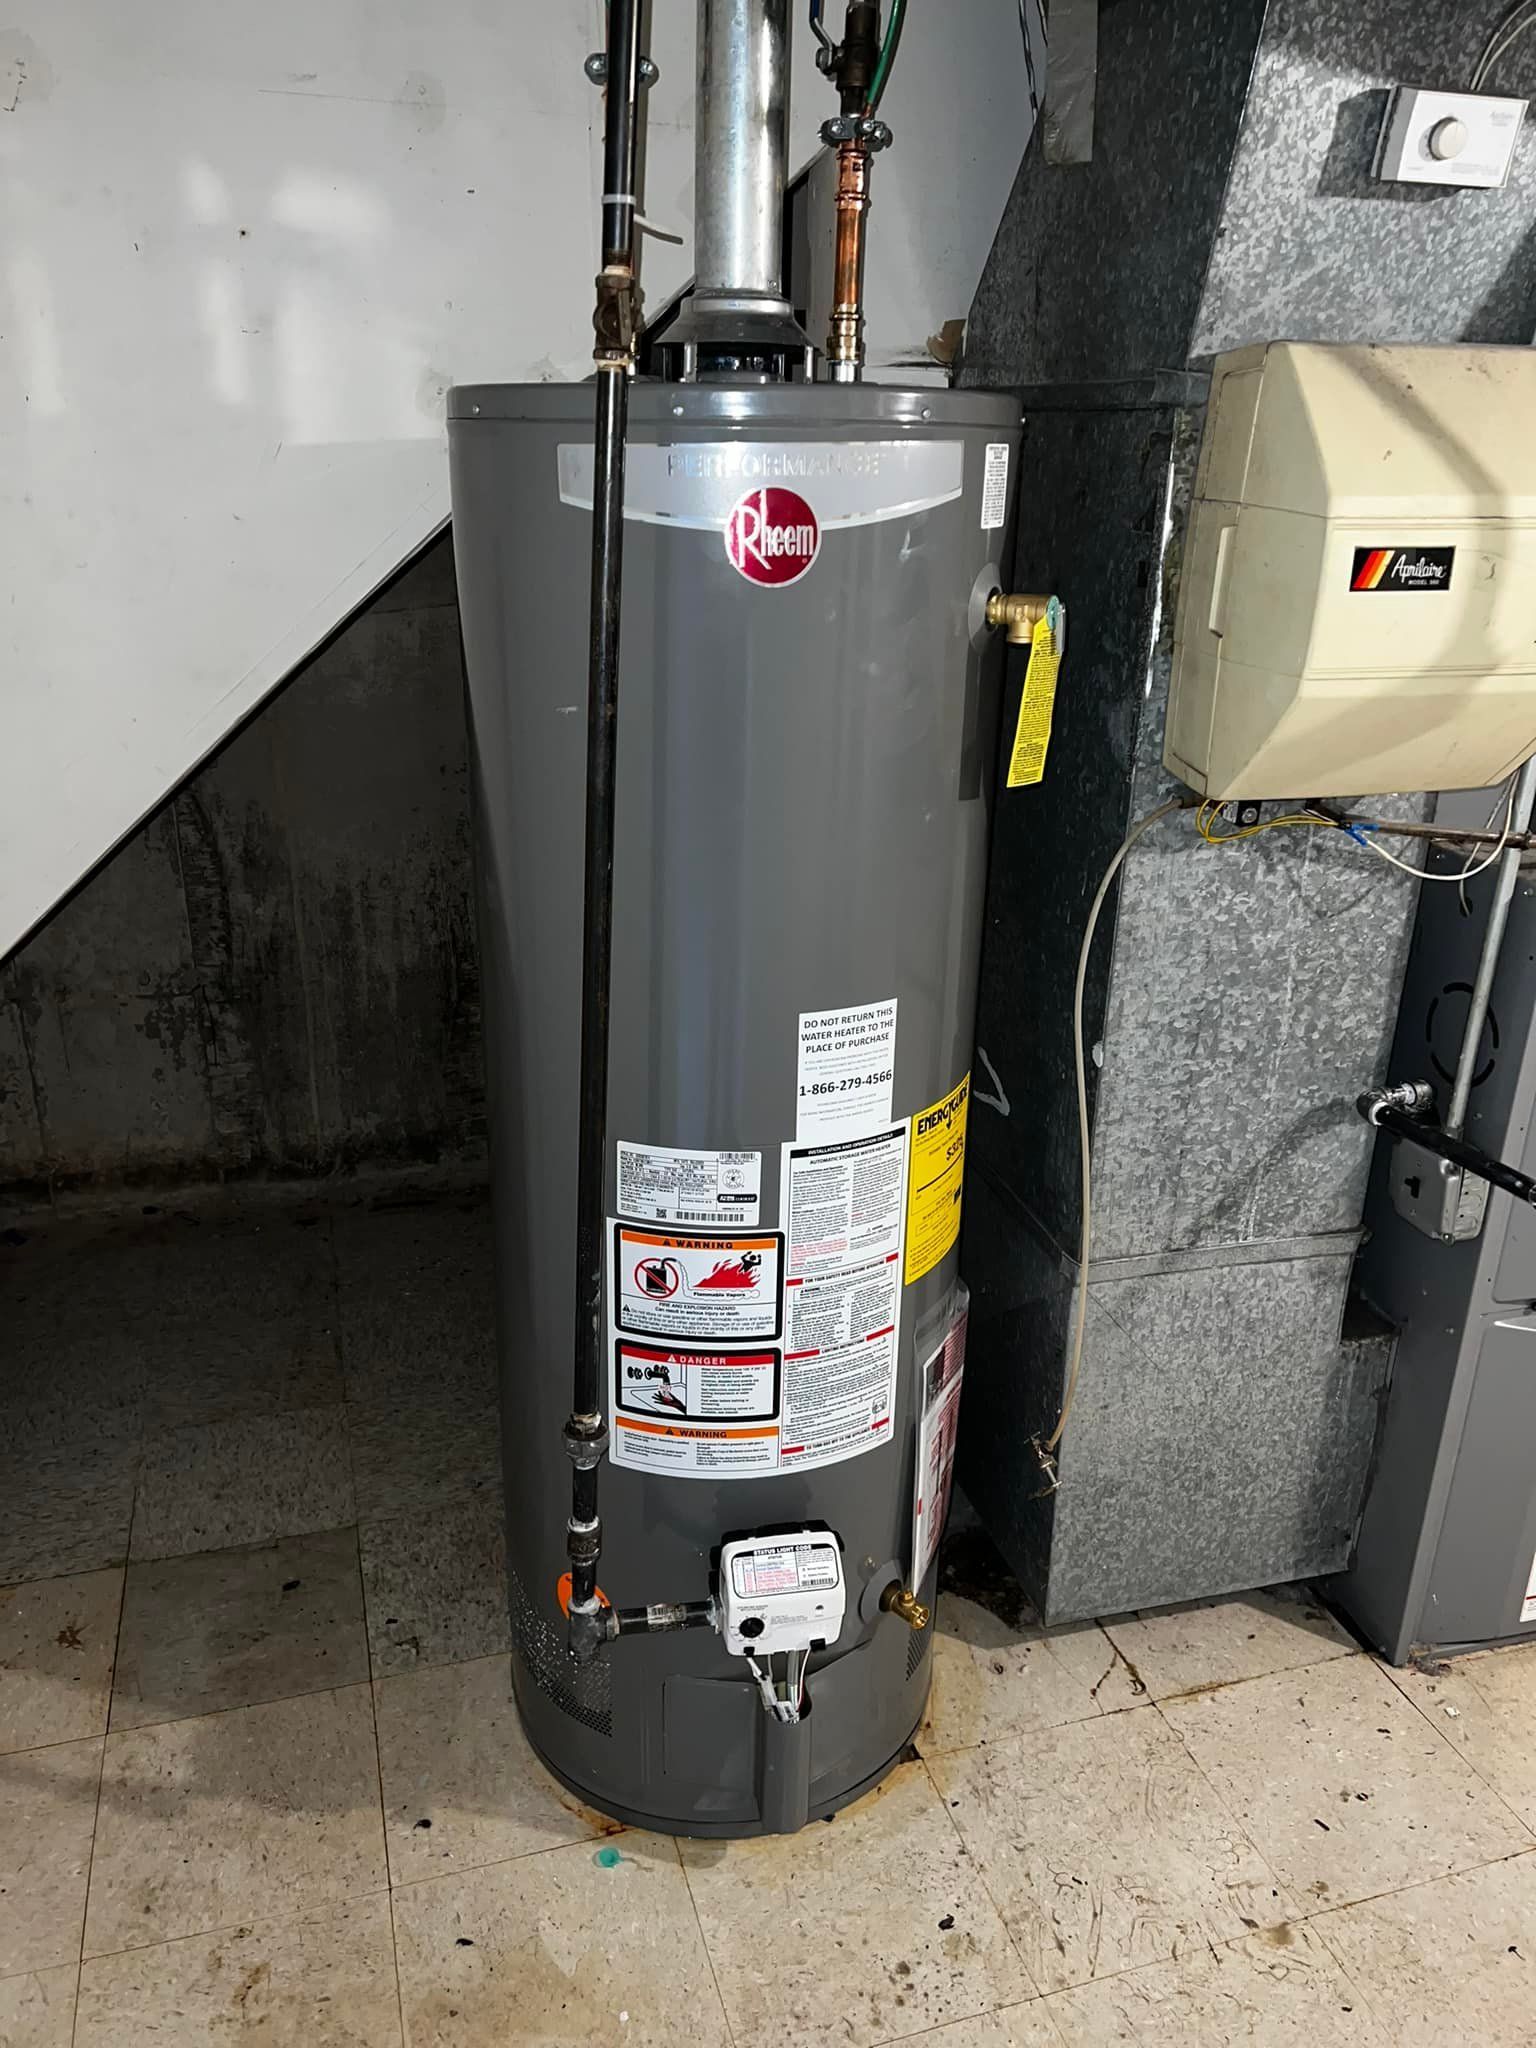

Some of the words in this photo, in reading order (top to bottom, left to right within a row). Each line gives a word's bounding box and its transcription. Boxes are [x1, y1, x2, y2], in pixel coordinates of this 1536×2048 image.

[668, 454, 880, 477] PERFORMANCE
[737, 488, 814, 569] Rheem
[1391, 554, 1447, 583] Aprilaire
[804, 1019, 818, 1029] DO
[820, 1017, 839, 1027] NOT
[841, 1012, 875, 1024] RETURN
[876, 1007, 893, 1017] THIS
[801, 1031, 832, 1041] WATER
[834, 1025, 866, 1038] HEATER
[867, 1023, 878, 1031] TO
[880, 1019, 894, 1029] THE
[806, 1043, 832, 1053] PLACE
[835, 1041, 847, 1050] OF
[848, 1032, 889, 1048] PURCHASE
[800, 1069, 892, 1096] 1-866-279-4566
[676, 1240, 733, 1249] WARNING
[680, 1356, 727, 1365] DANGER
[680, 1430, 727, 1438] WARNING
[753, 1548, 775, 1556] STATUS
